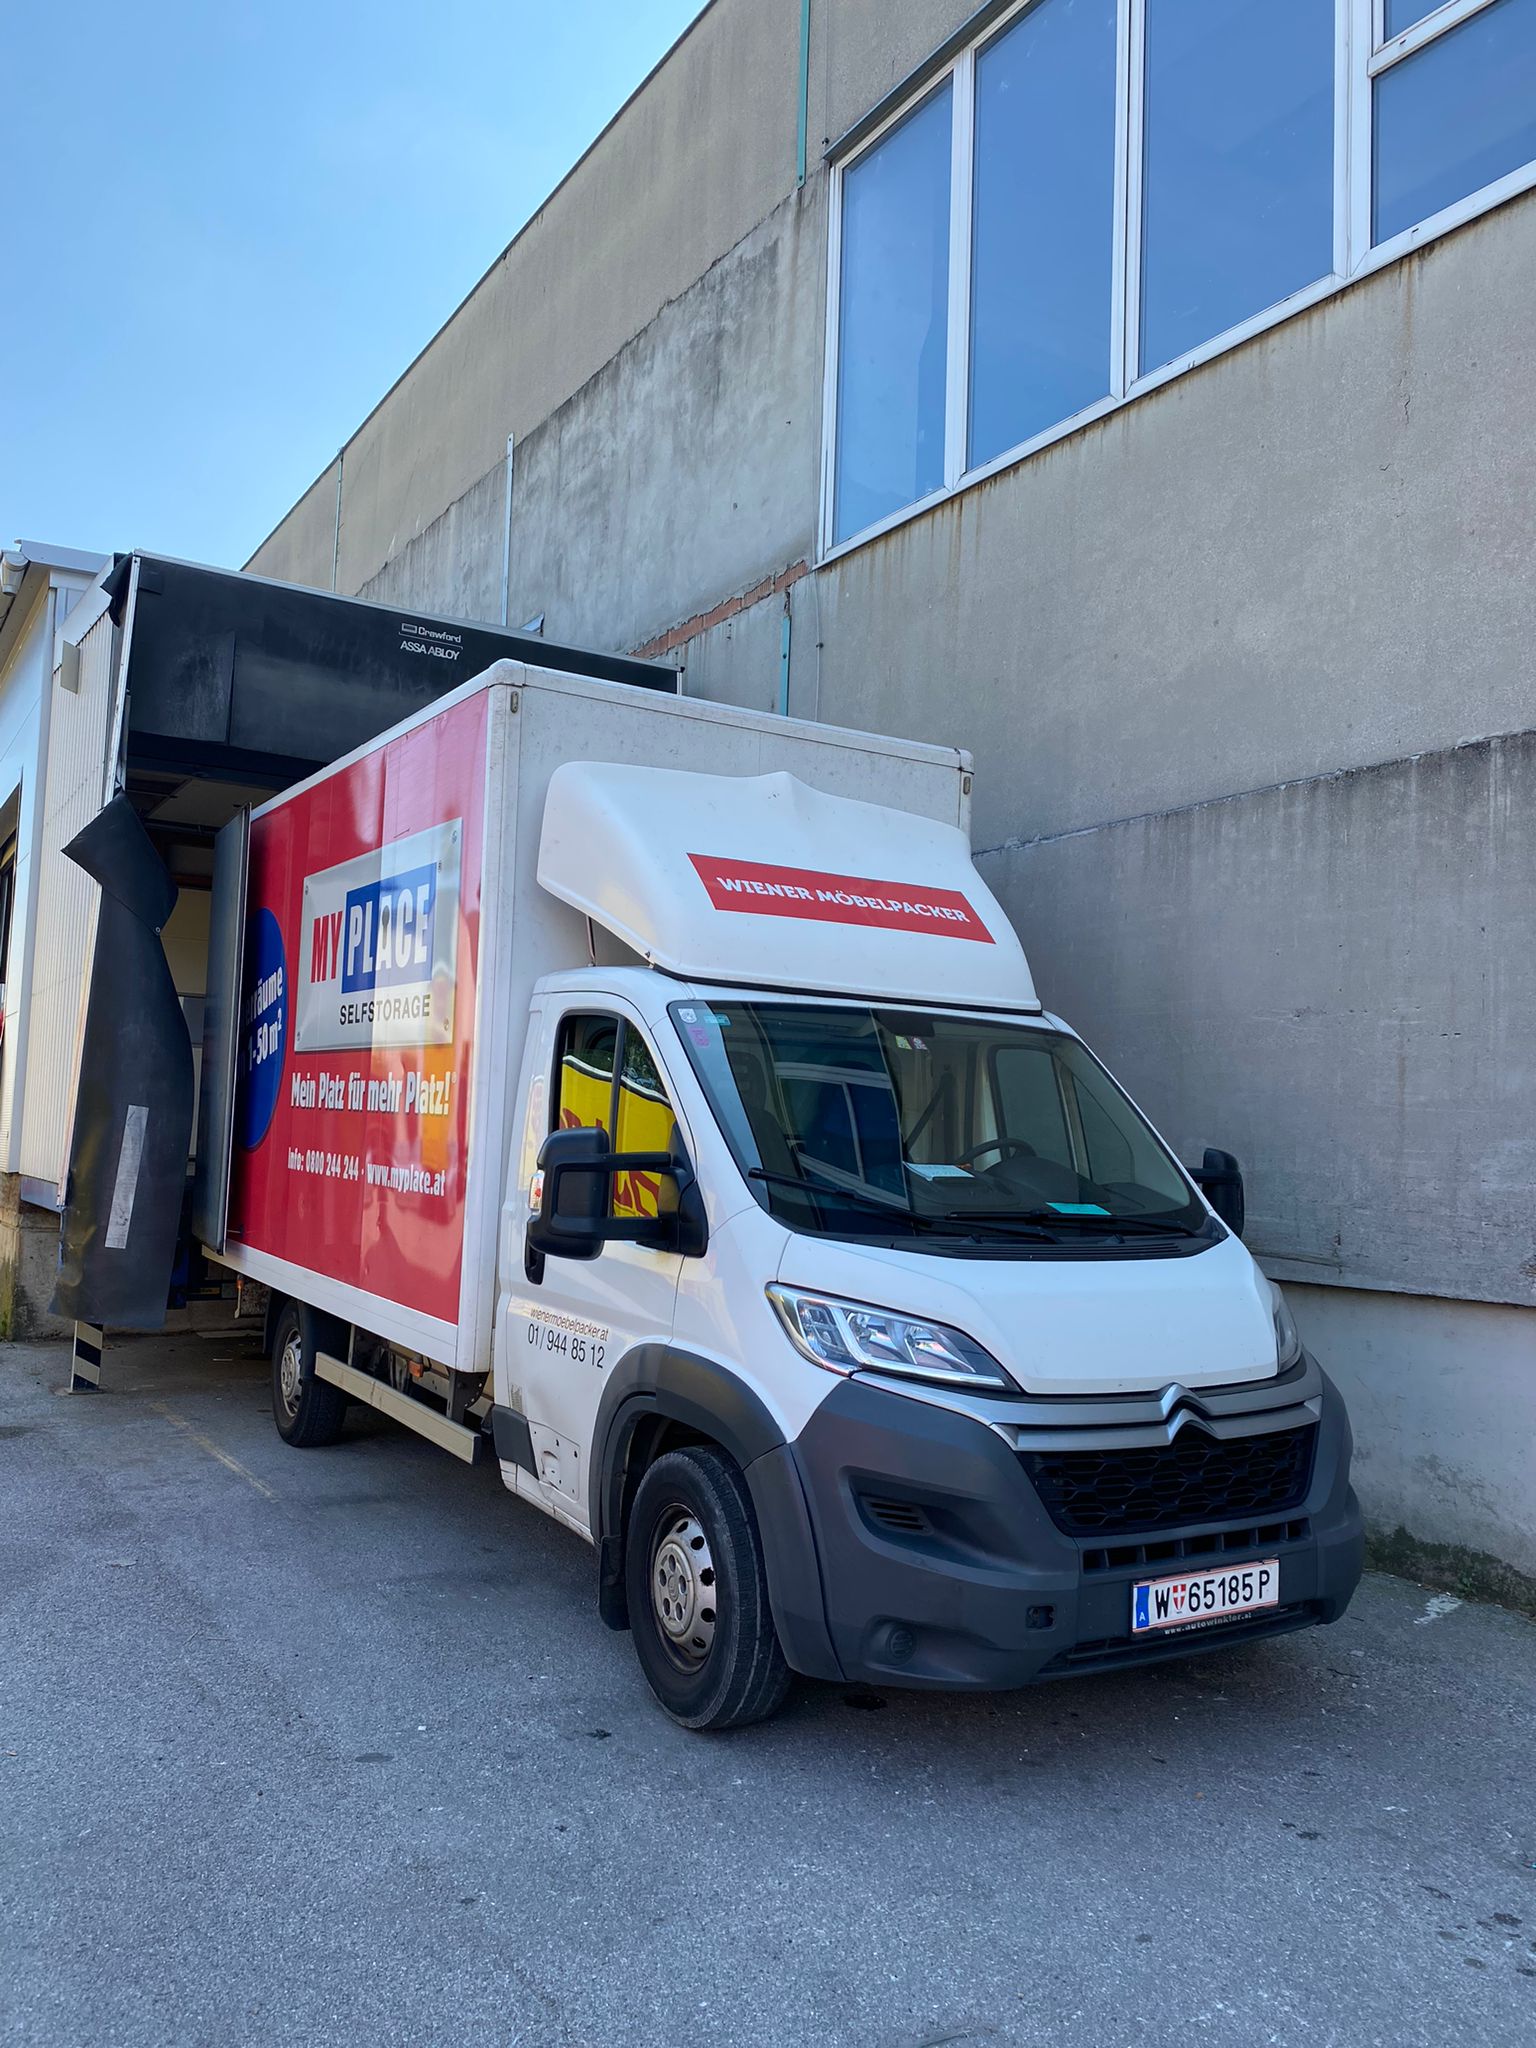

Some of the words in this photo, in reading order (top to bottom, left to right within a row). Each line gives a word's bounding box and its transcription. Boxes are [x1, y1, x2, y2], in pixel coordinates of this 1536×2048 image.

[400, 640, 427, 654] ASSA
[427, 646, 460, 660] ABLOY
[418, 626, 462, 643] Crawford
[716, 876, 815, 901] WIENER
[817, 889, 971, 923] MÖBELPACKER
[339, 994, 431, 1026] SELFSTORAGE
[290, 1072, 316, 1109] Mein
[318, 1072, 346, 1110] Platz
[348, 1071, 366, 1111] für
[367, 1071, 403, 1113] mehr
[287, 1147, 304, 1172] Info:
[306, 1149, 325, 1175] 0800
[326, 1152, 342, 1178] 244
[343, 1154, 359, 1181] 244
[367, 1163, 446, 1197] www.myplace.at
[530, 1306, 609, 1342] wienermoebelpacker.at
[571, 1338, 586, 1362] 85
[591, 1344, 605, 1369] 12
[1138, 1611, 1146, 1622] A
